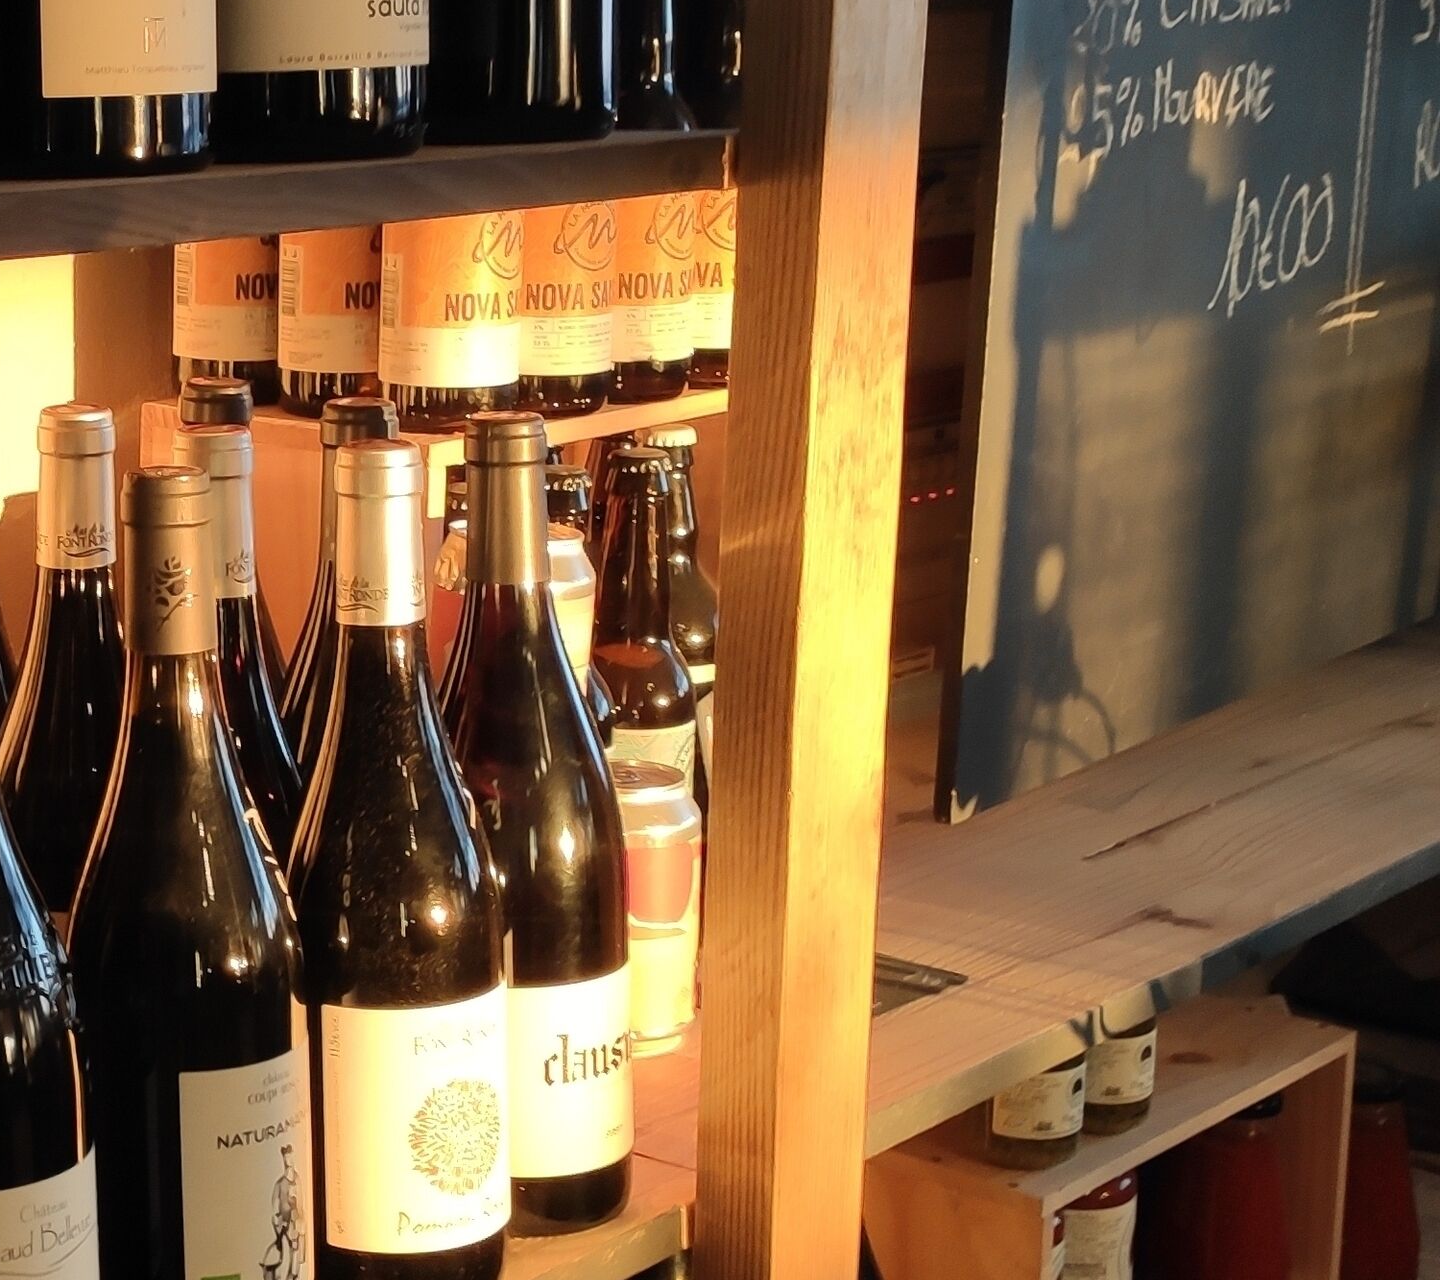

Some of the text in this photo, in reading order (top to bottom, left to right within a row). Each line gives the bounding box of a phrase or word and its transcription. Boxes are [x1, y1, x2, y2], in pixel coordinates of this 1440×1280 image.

[525, 280, 611, 312] NOVA SA
[618, 272, 675, 300] NOVA
[445, 292, 502, 322] NOVA
